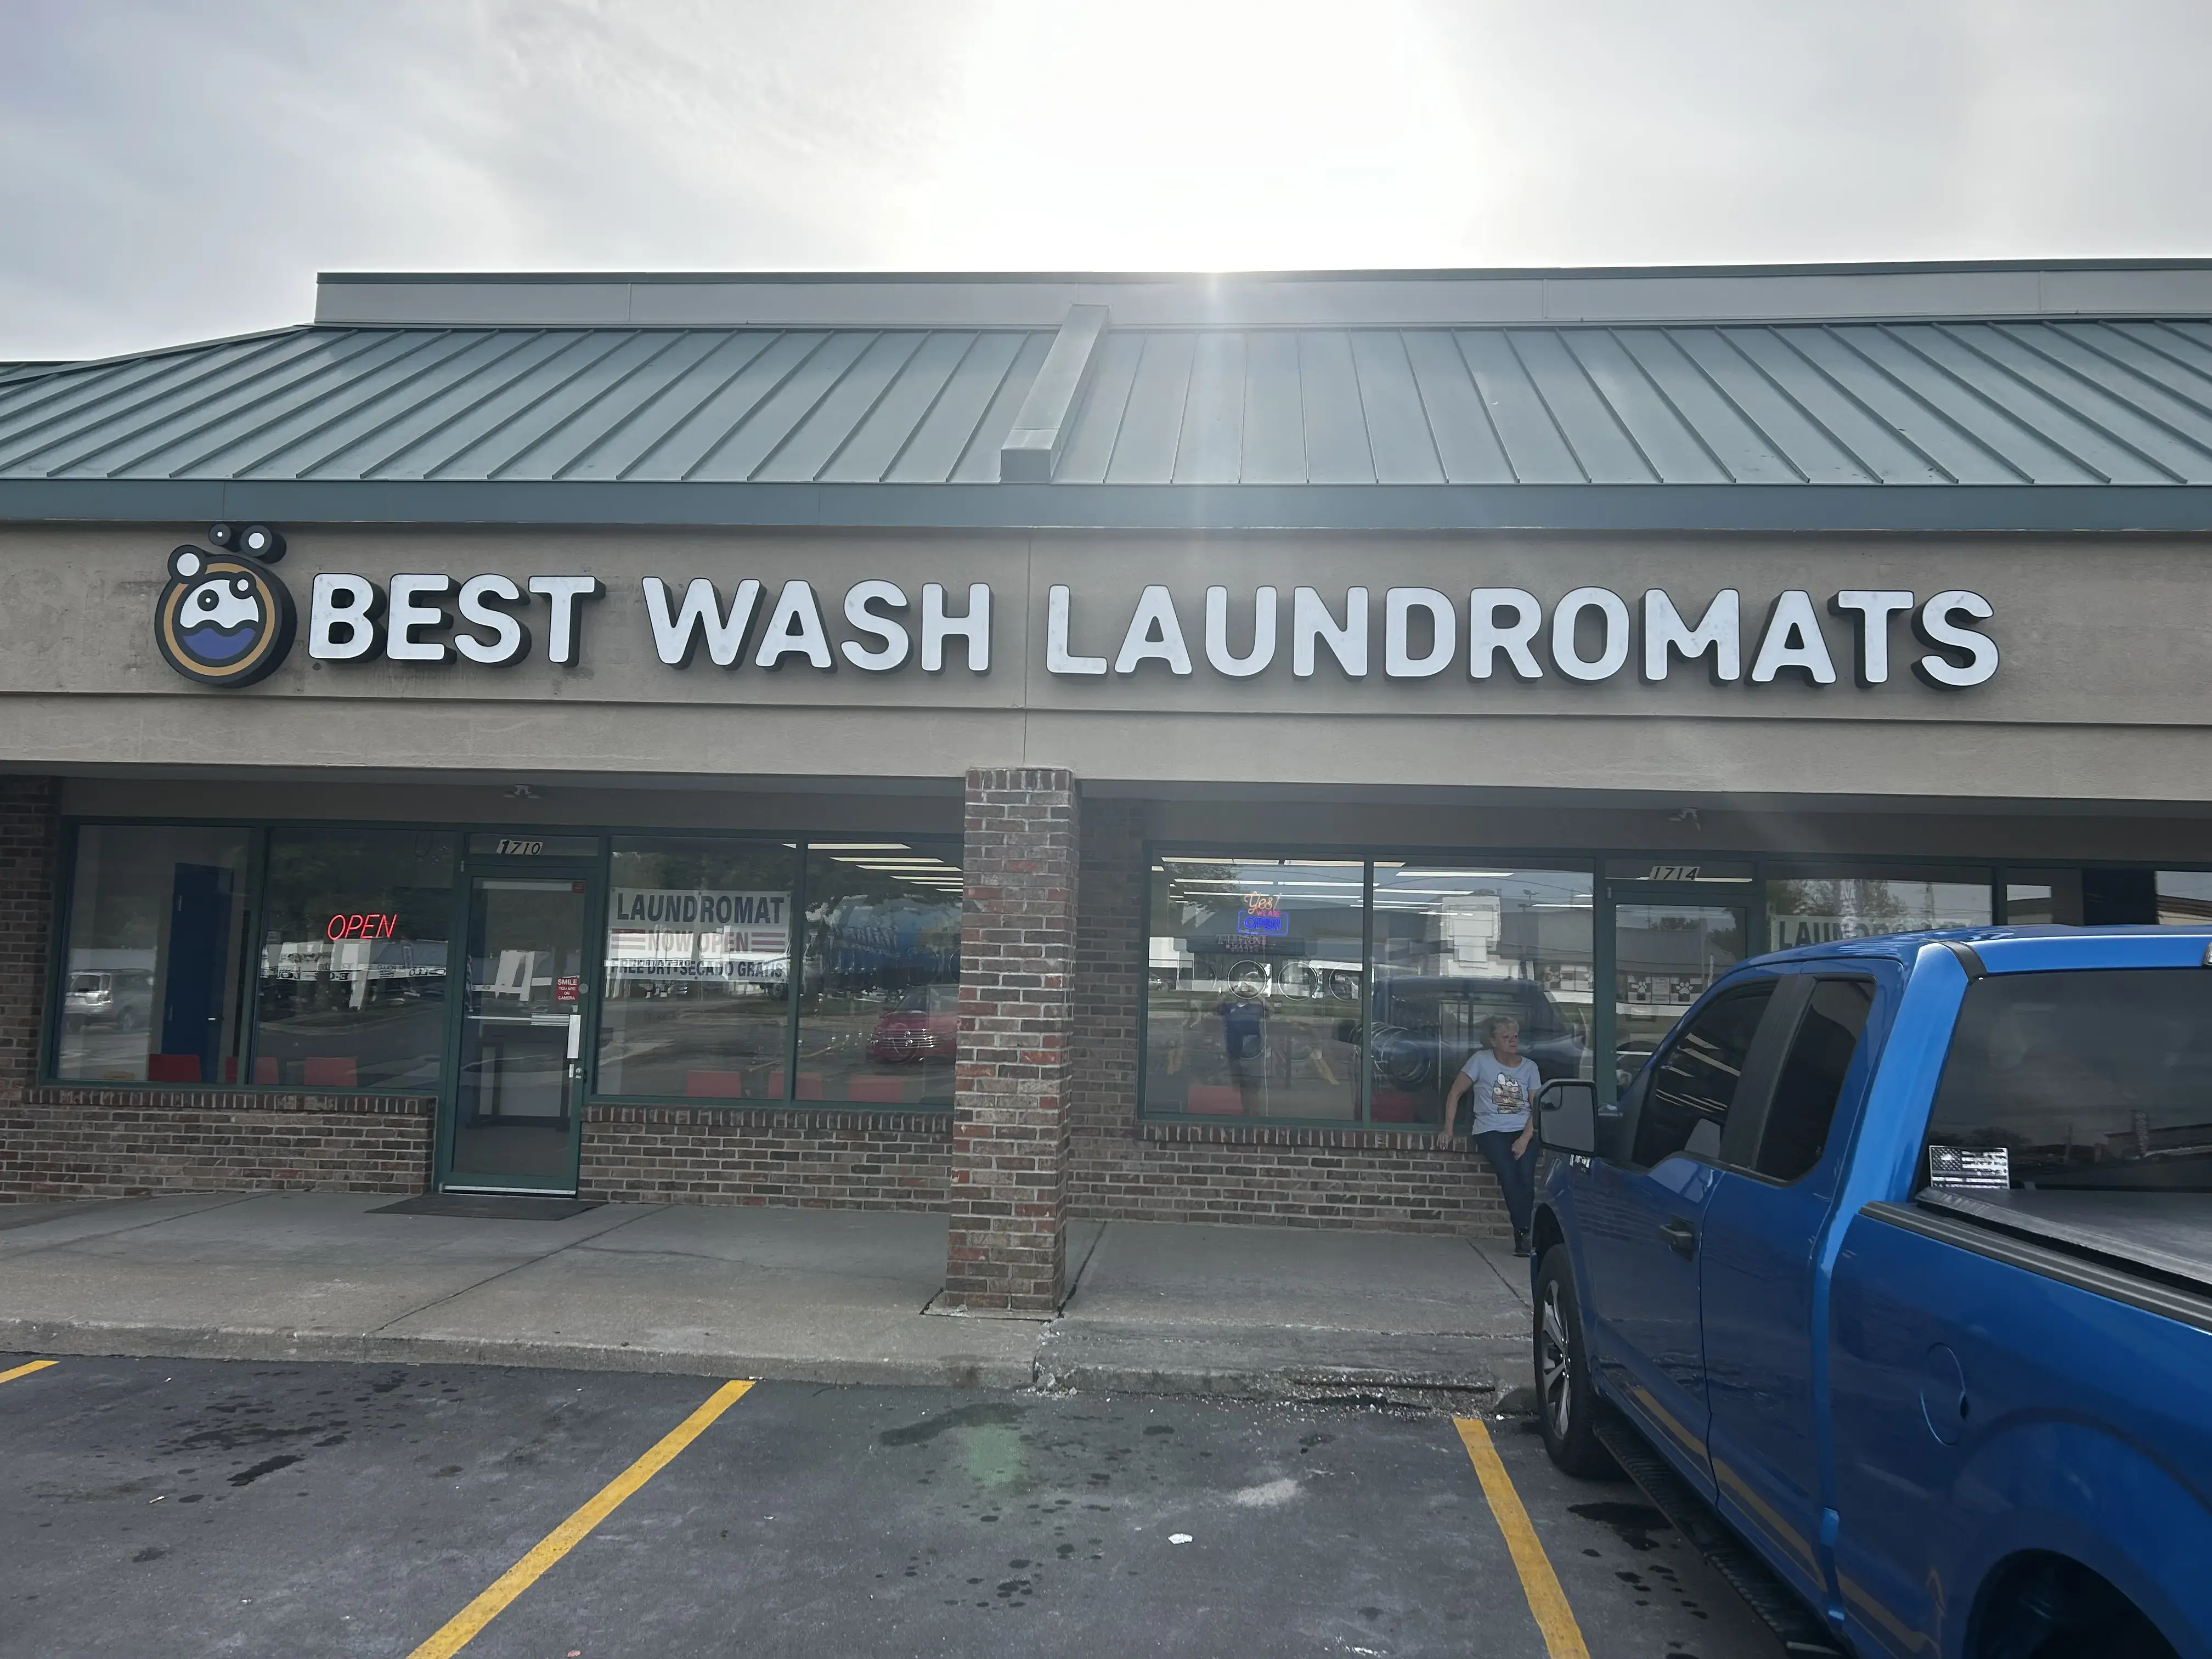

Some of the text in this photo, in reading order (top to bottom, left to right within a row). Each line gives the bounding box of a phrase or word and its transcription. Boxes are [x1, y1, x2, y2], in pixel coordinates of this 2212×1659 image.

[308, 572, 2000, 688] BEST WASH LAUNDROMATS
[501, 839, 541, 855] 1710
[1653, 866, 1697, 881] 1714
[617, 893, 785, 924] LAUNDROMAT
[327, 913, 397, 941] OPEN
[1243, 916, 1282, 931] OPEN
[648, 929, 749, 953] NOW OPEN
